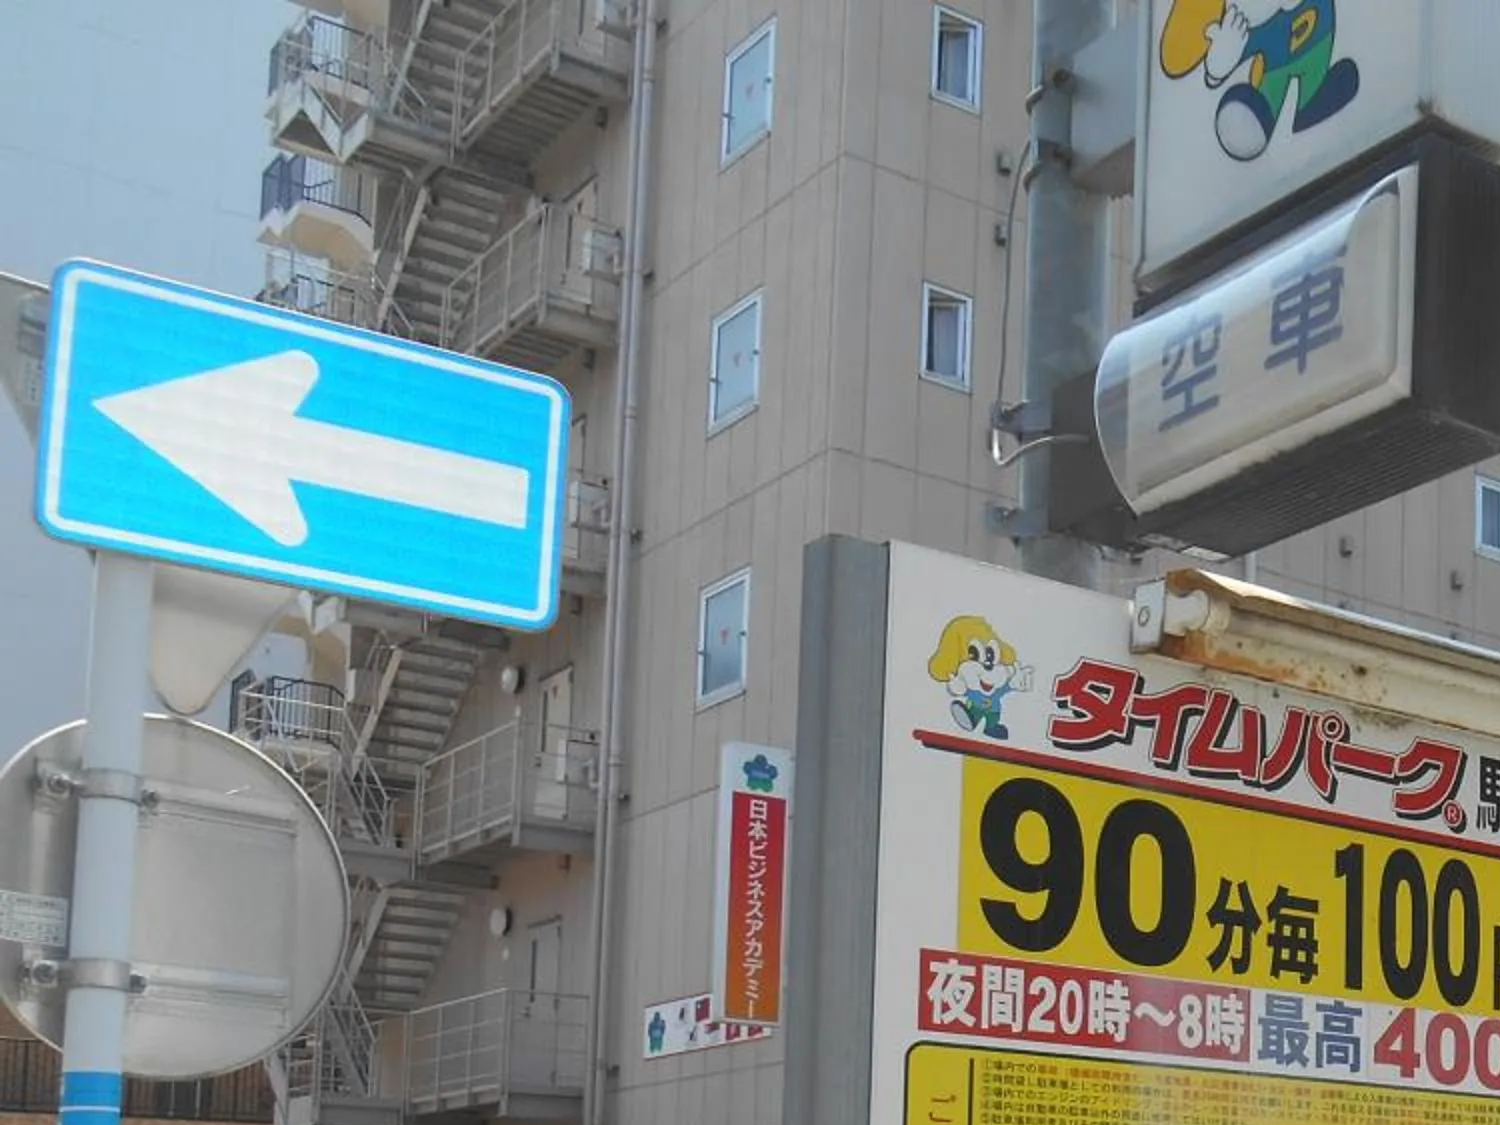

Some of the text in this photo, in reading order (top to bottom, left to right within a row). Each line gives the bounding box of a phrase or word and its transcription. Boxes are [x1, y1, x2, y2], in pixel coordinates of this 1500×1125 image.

[1158, 245, 1347, 431] 空車
[1048, 656, 1467, 830] タイムパーク
[1258, 993, 1362, 1073] 最高
